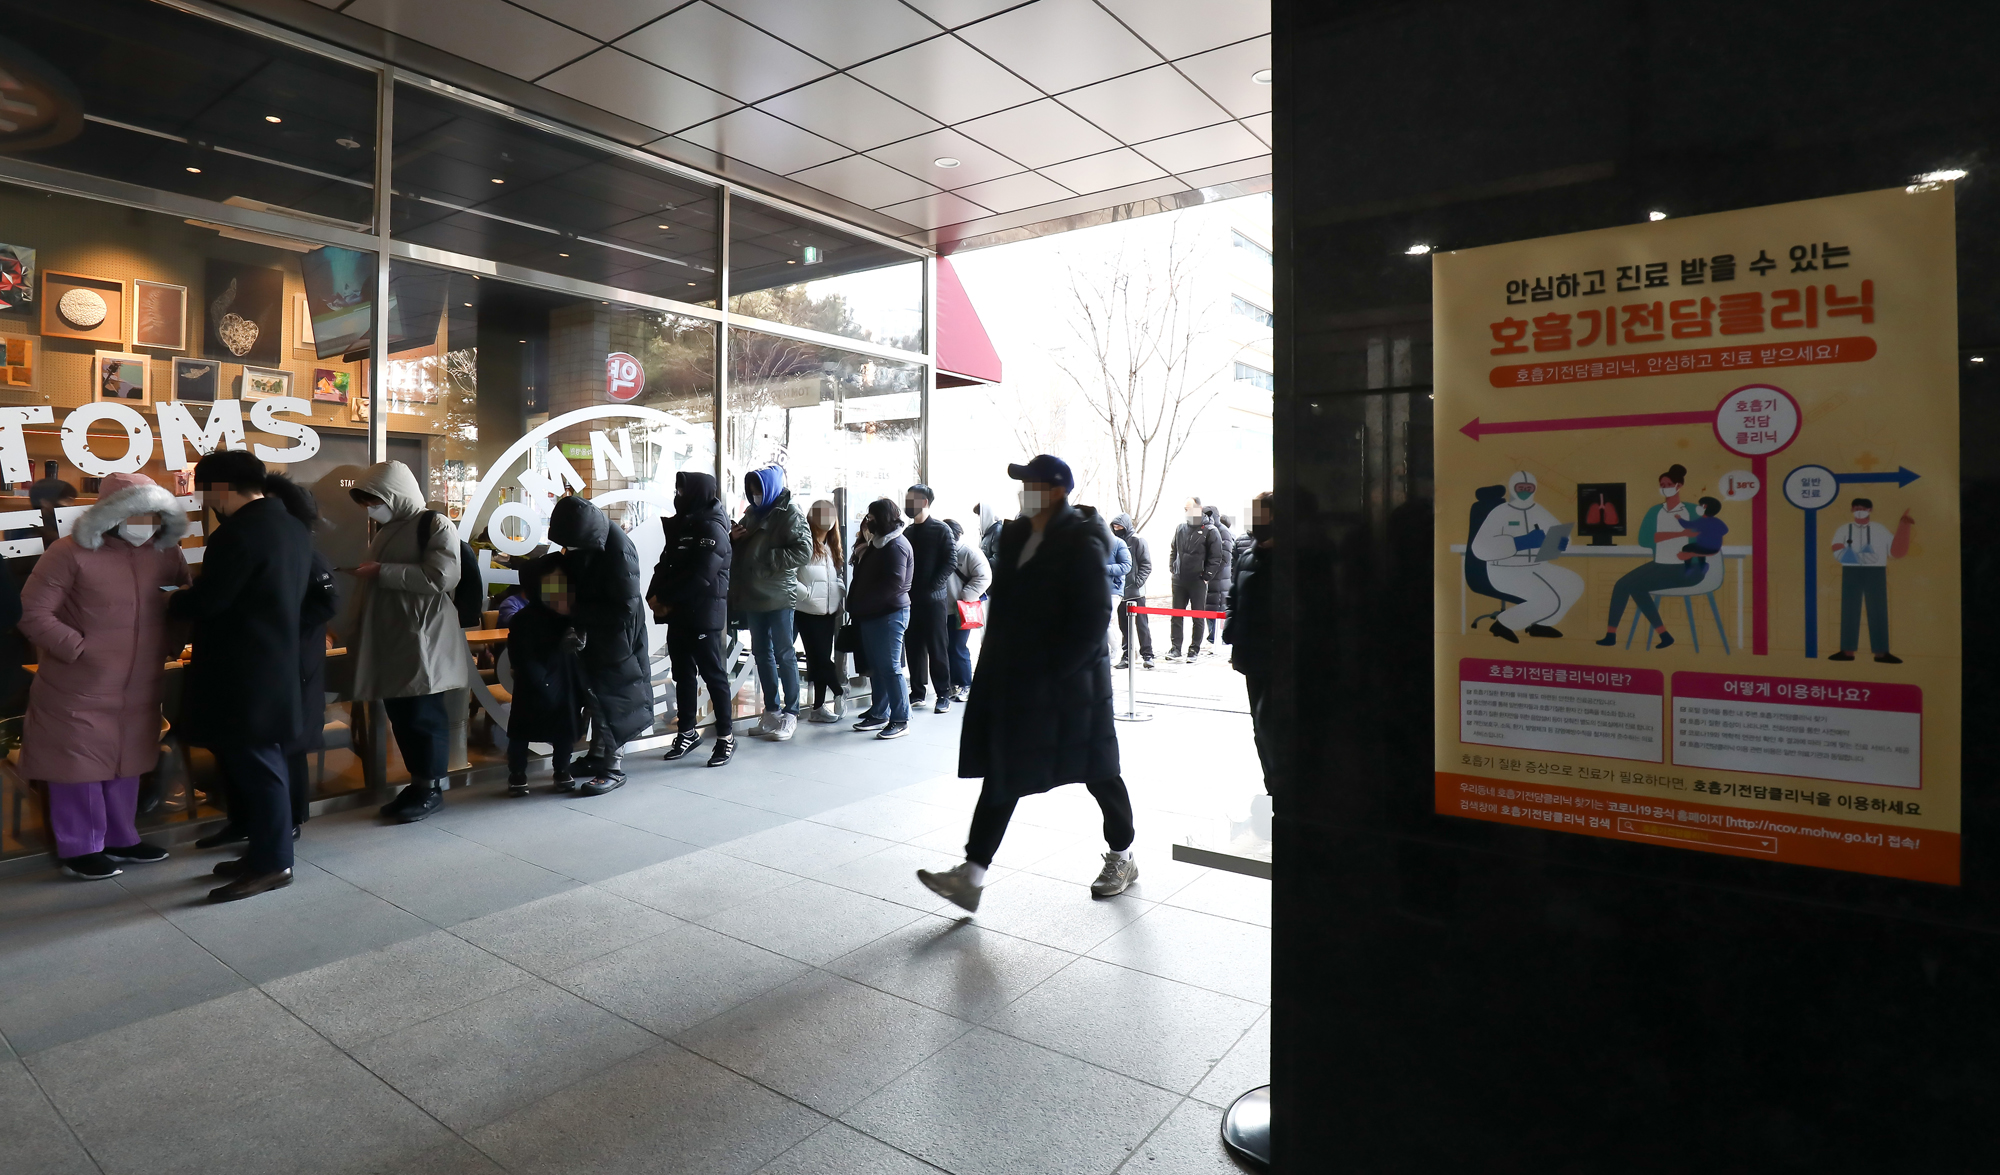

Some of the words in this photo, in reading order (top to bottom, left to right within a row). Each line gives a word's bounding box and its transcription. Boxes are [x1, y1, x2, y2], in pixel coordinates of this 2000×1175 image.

[1506, 270, 1606, 304] 안심하고
[1617, 262, 1670, 291] 진료
[1680, 254, 1737, 284] 받을
[1749, 251, 1776, 275] 수
[1789, 242, 1851, 271] 있는
[1489, 278, 1876, 356] 호흡기전담클리닉
[1516, 356, 1641, 384] 호흡기전담클리닉,
[1647, 352, 1712, 373] 안심하고
[1720, 350, 1753, 366] 진료
[1761, 344, 1840, 364] 받으세요!
[1735, 400, 1776, 412] 호흡기
[1743, 415, 1770, 428] 전담
[0, 397, 321, 483] TOMS
[1736, 431, 1777, 444] 클리닉
[1801, 478, 1821, 487] 일반
[1801, 489, 1821, 498] 진료
[1488, 664, 1632, 687] 호흡기전담클리닉이란?
[1724, 680, 1770, 697] 어떻게
[1777, 683, 1871, 702] 이용하나요?
[1461, 753, 1494, 768] 호흡기
[1499, 758, 1521, 771] 질환
[1525, 761, 1573, 777] 증상으로
[1578, 767, 1615, 782] 진료가
[1620, 772, 1688, 790] 필요하다면,
[1693, 779, 1831, 807] 호흡기전담클리닉을
[1837, 794, 1922, 815] 이용하세요
[1460, 799, 1497, 813] 검색창에
[1500, 805, 1585, 826] 호흡기전담클리닉
[1589, 816, 1610, 830] 검색
[1460, 782, 1495, 797] 우리동네
[1498, 787, 1572, 806] 호흡기전담클리닉
[1575, 796, 1604, 810] 찾기는
[1653, 806, 1675, 821] 공식
[1726, 814, 1883, 846] [http://ncov.mohw.go.kr]
[1888, 835, 1920, 850] 접속!
